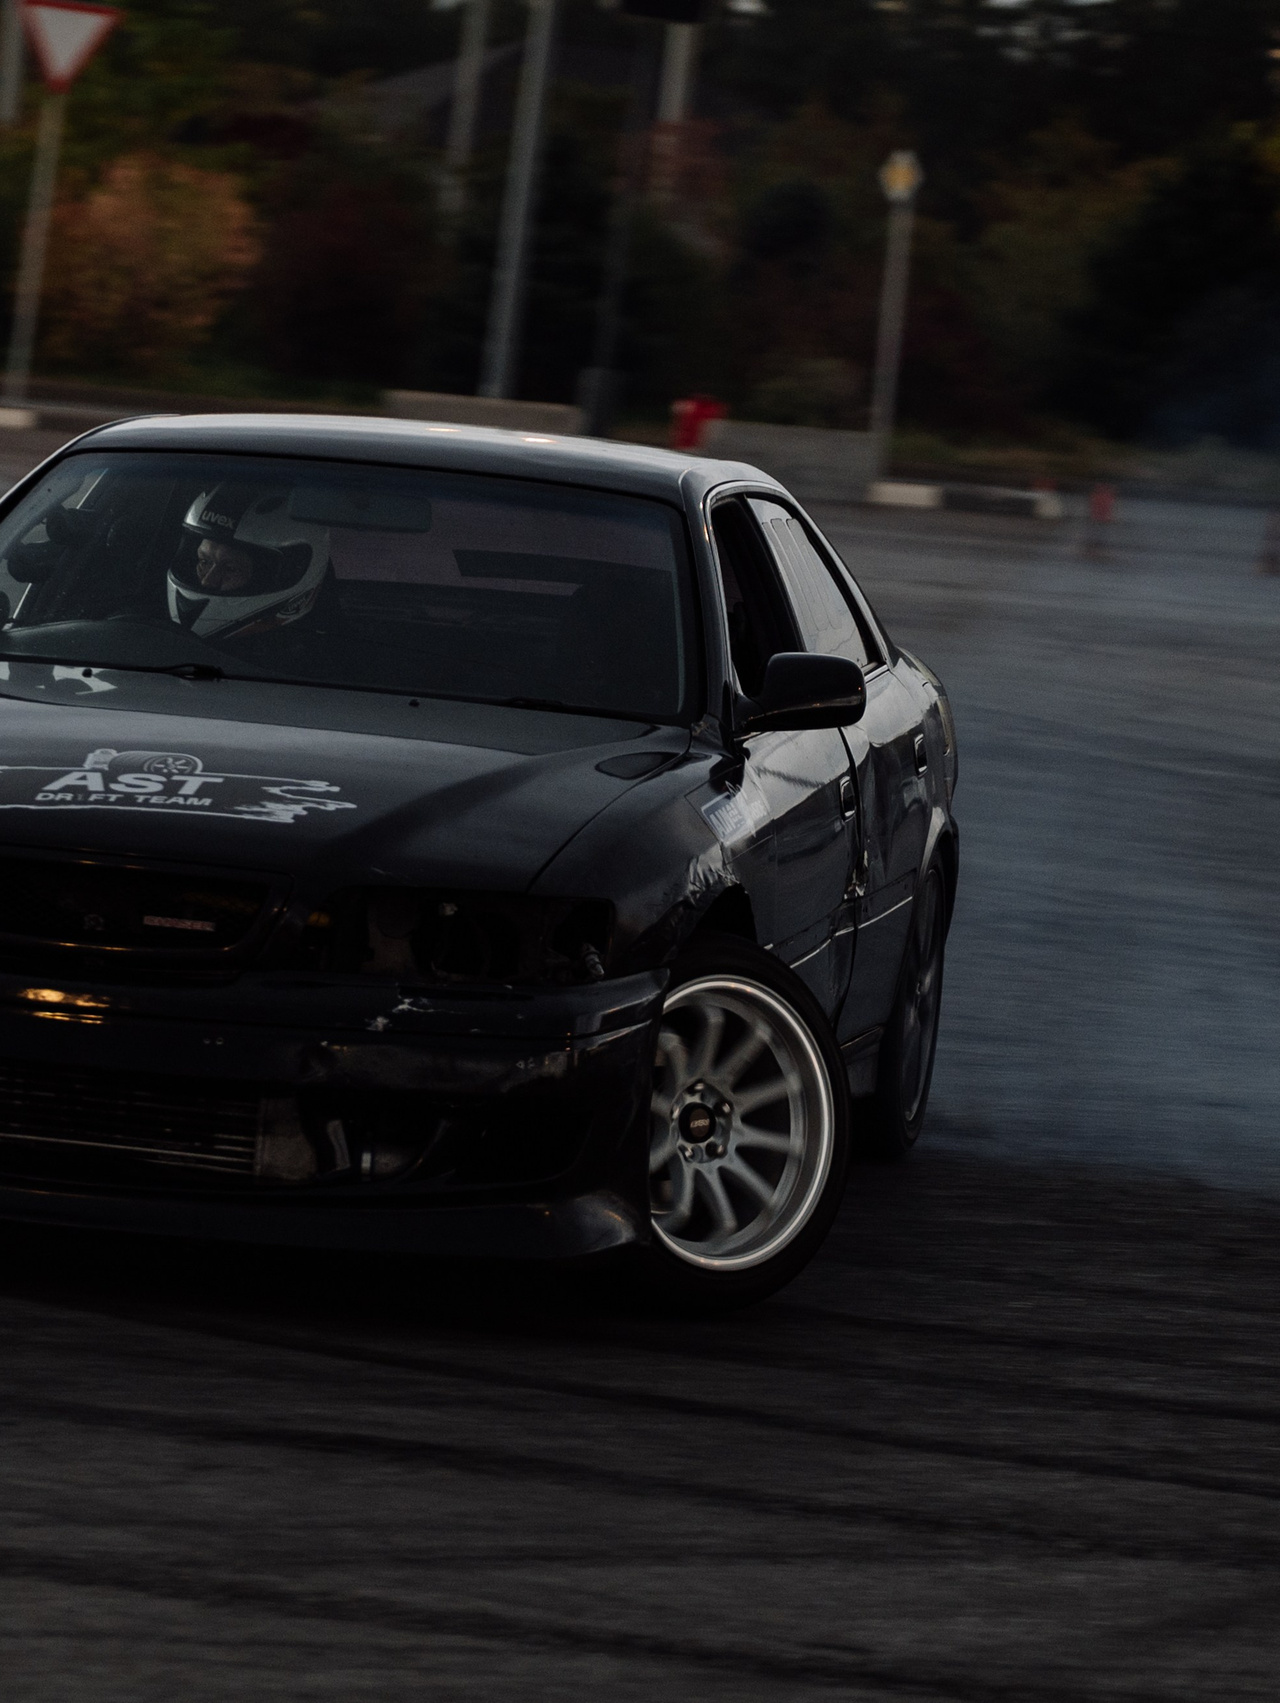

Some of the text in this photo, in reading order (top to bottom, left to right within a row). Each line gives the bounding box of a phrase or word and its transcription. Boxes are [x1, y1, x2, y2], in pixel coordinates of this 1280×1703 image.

[202, 510, 236, 529] uvex
[42, 772, 224, 796] AST
[134, 795, 214, 806] TEAM
